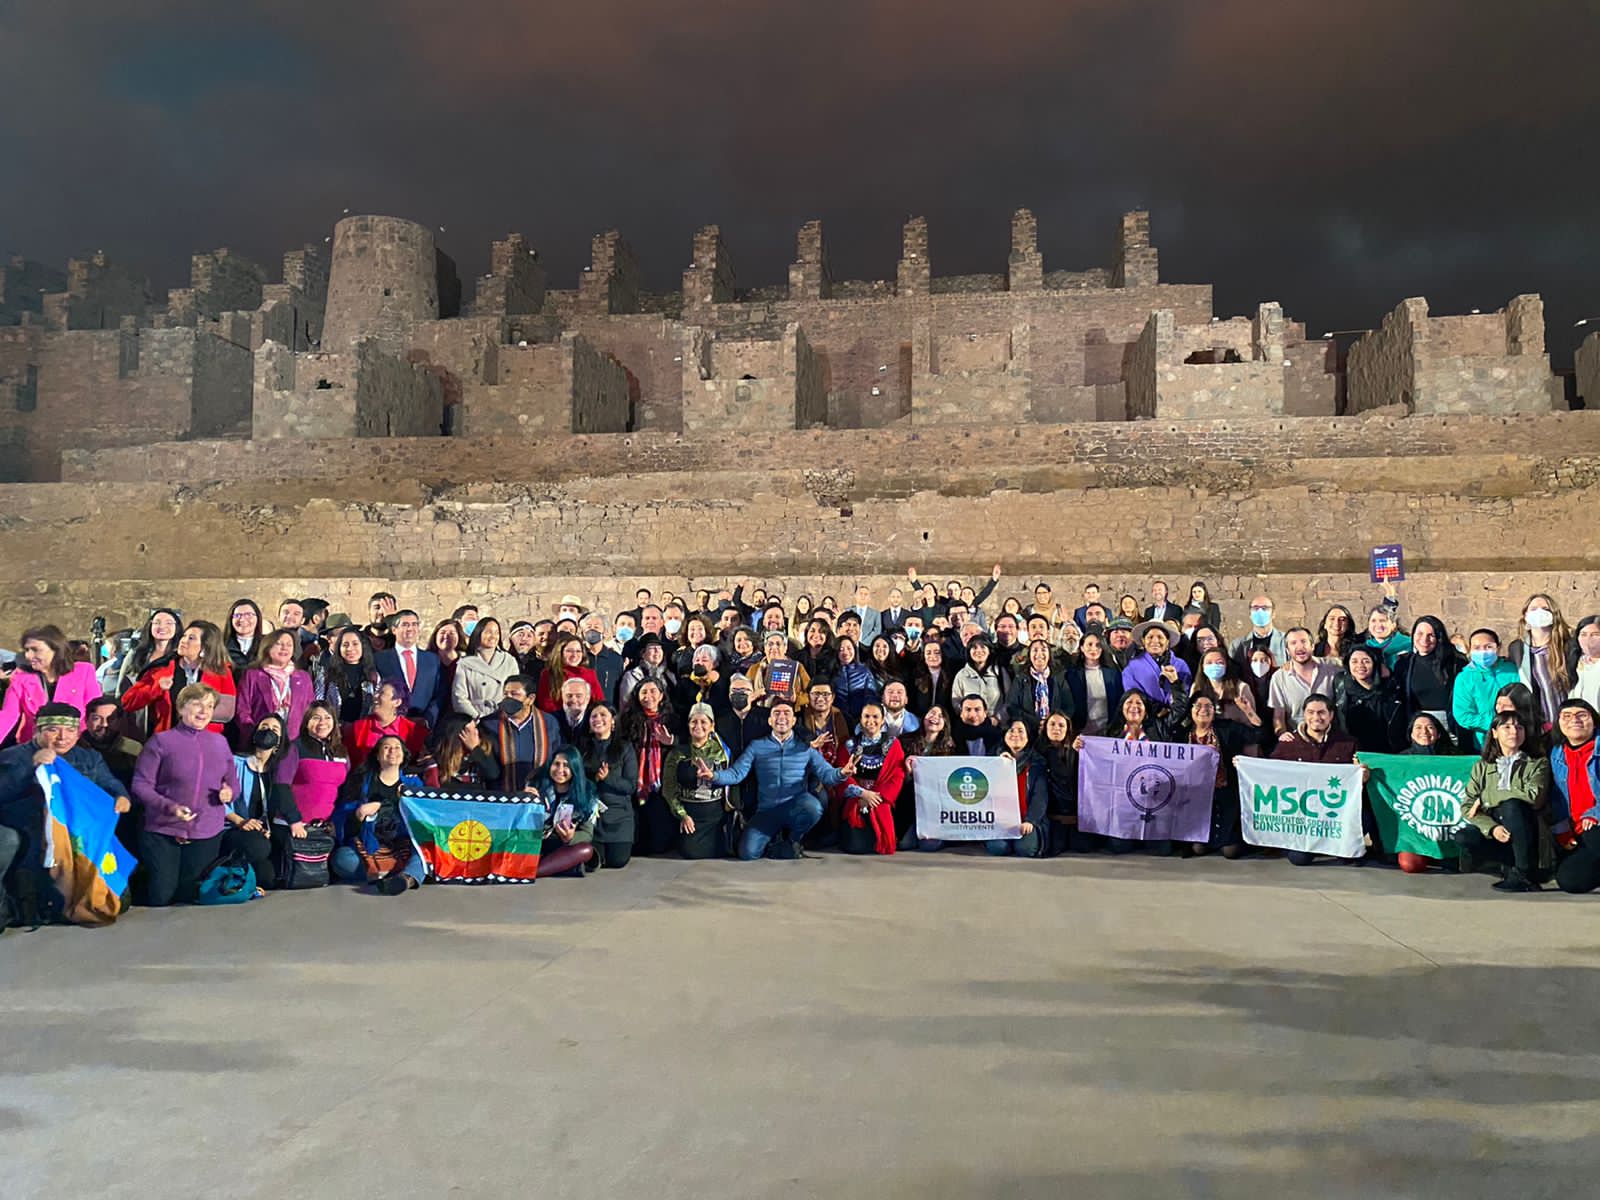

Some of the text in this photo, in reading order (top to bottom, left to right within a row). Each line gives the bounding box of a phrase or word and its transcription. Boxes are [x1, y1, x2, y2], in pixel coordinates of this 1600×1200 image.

[1112, 740, 1194, 760] ANAMURI
[1393, 774, 1467, 813] COORDINAD
[940, 810, 995, 824] PUEBLO
[1421, 795, 1454, 822] 8M
[1253, 813, 1305, 825] MOVIMIENTOS
[1253, 820, 1343, 839] CONSTITUYENTES
